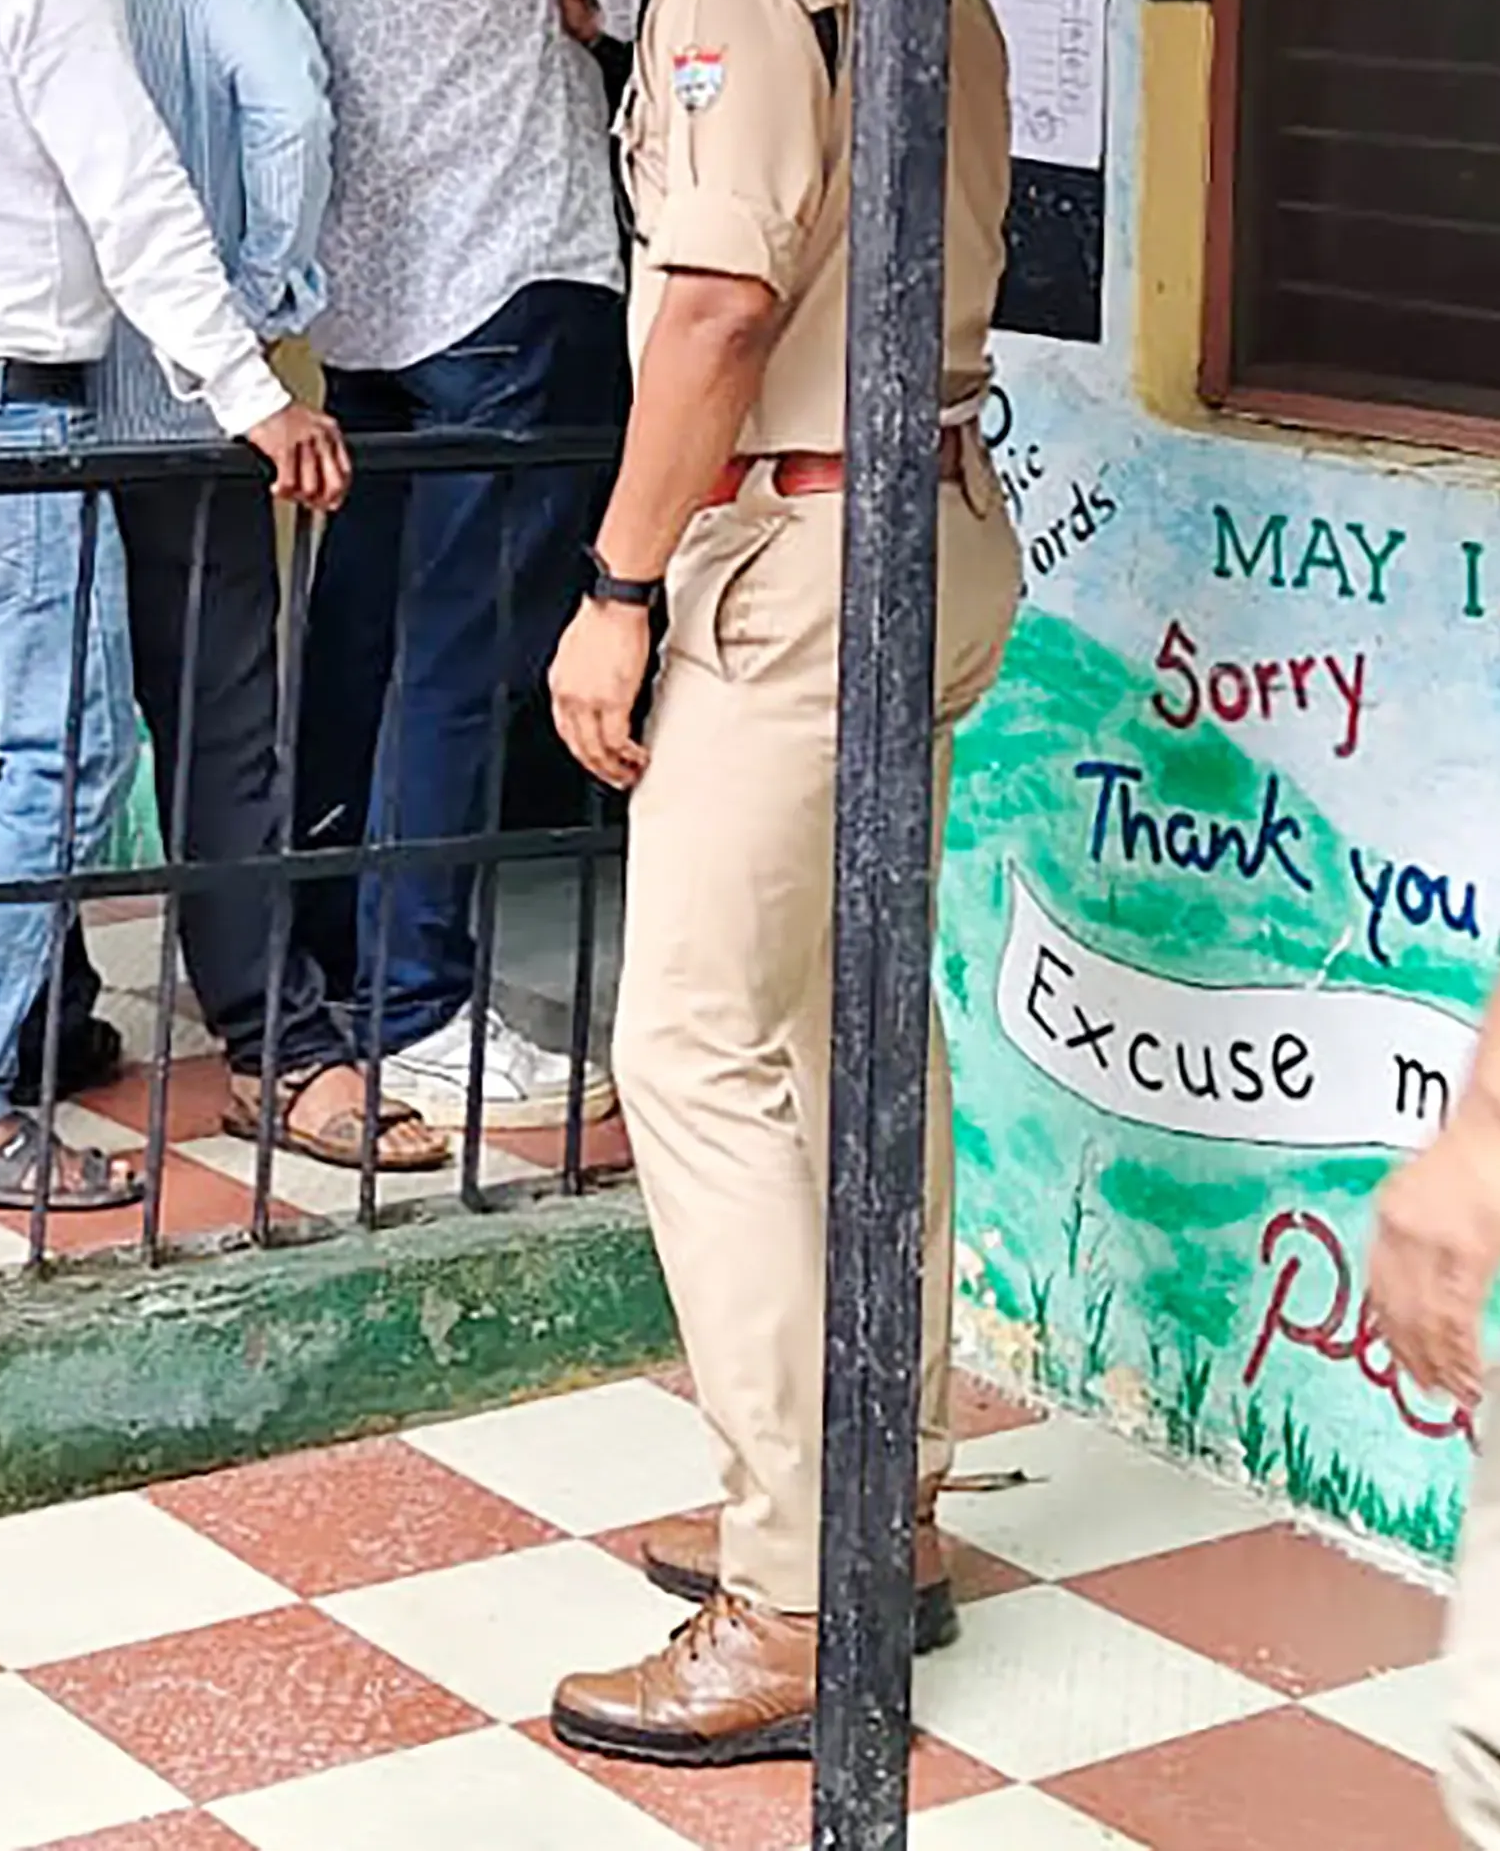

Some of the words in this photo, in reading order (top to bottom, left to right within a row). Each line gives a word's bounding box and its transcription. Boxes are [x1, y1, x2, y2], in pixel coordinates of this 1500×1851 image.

[1021, 480, 1118, 598] ords
[1212, 504, 1406, 604] MAY
[1461, 541, 1484, 617] I
[1151, 619, 1365, 758] Sorry
[1074, 761, 1314, 892] Thank
[1350, 849, 1481, 969] you
[1027, 945, 1315, 1104] Excuse
[1394, 1053, 1450, 1130] m
